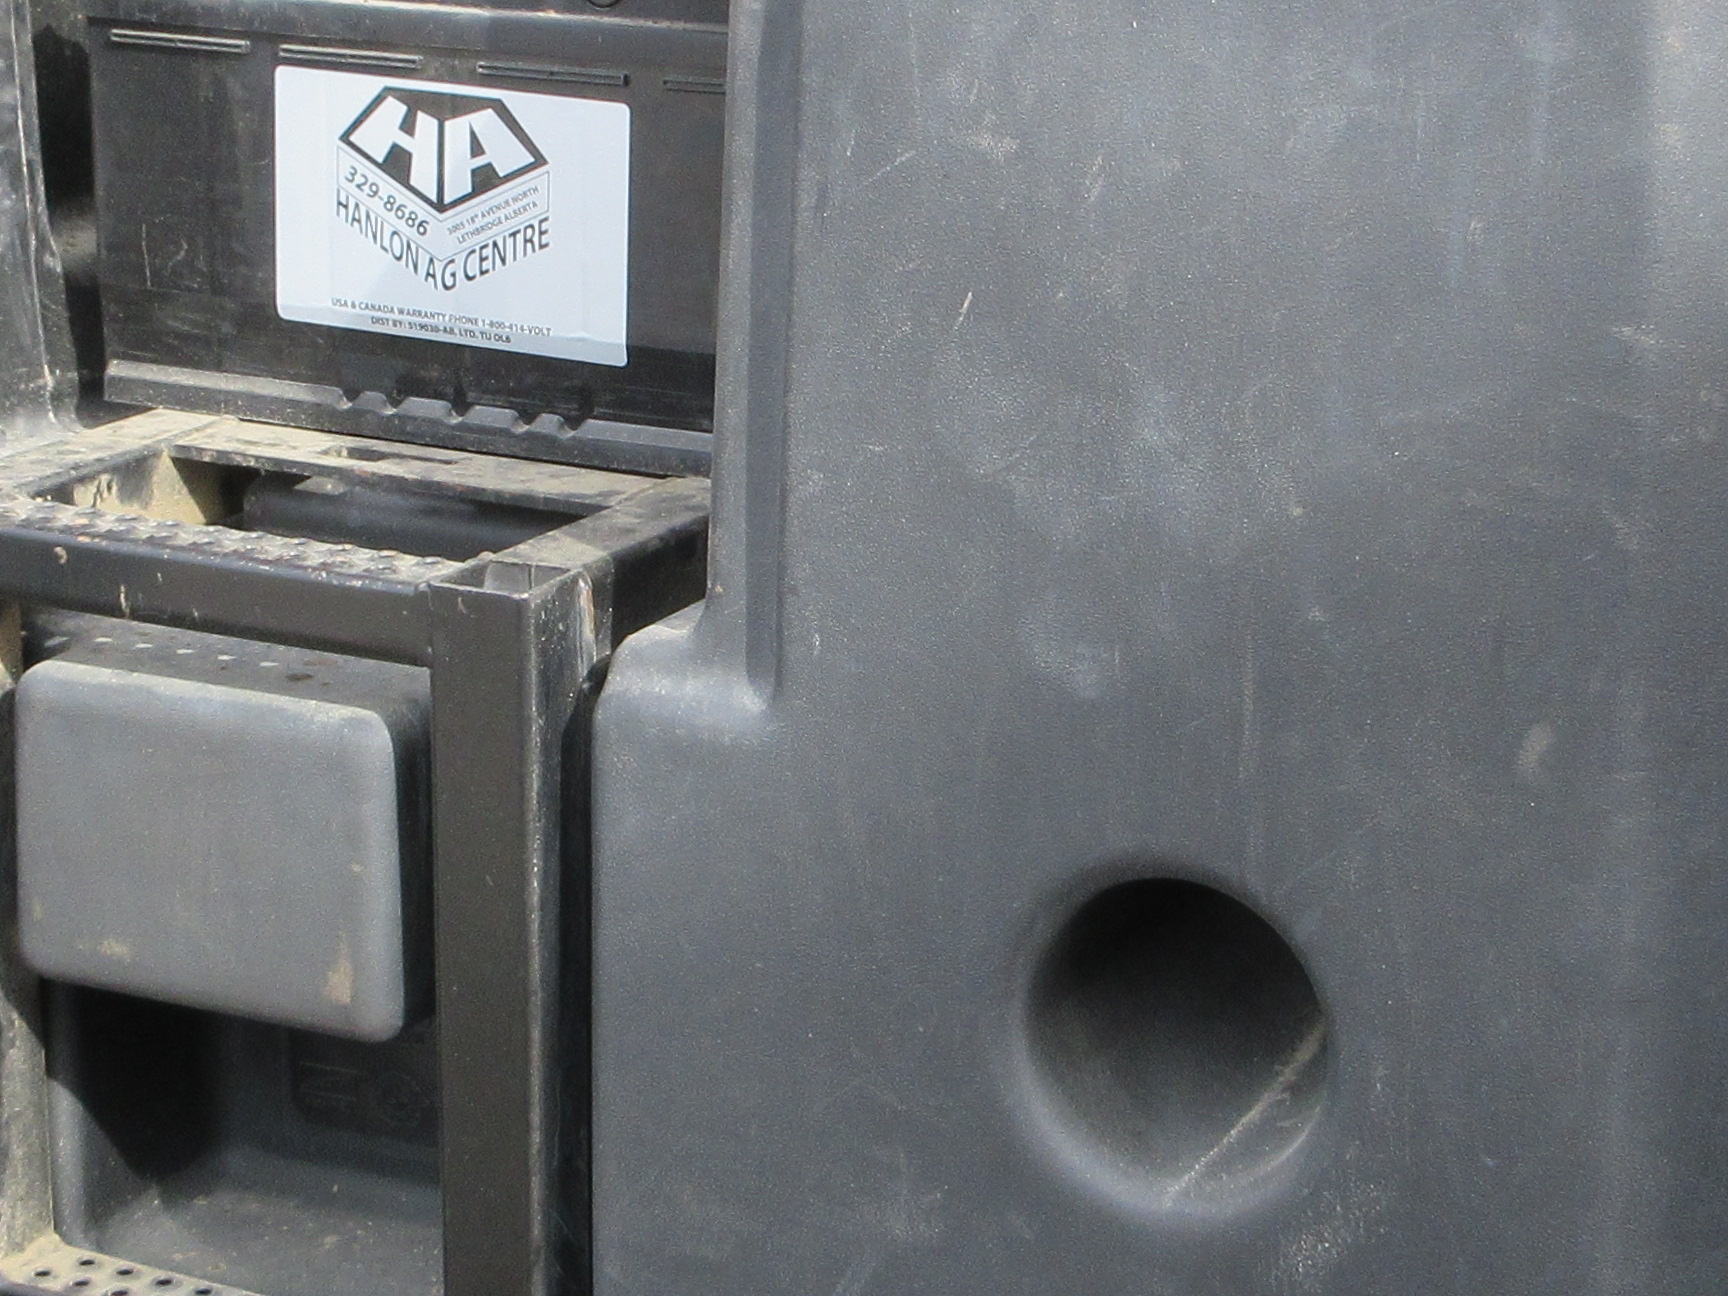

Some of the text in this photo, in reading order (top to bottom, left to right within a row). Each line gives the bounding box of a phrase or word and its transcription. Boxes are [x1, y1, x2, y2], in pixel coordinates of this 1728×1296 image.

[348, 94, 536, 205] HA
[343, 165, 431, 237] 329-8686
[480, 198, 511, 220] AVENUE
[511, 185, 540, 206] NORTH
[503, 200, 539, 223] ALBERTA
[336, 188, 551, 292] HANLON AG CENTRE
[331, 297, 349, 309] USA
[358, 301, 396, 316] CANADA
[396, 306, 446, 322] WARRANTY
